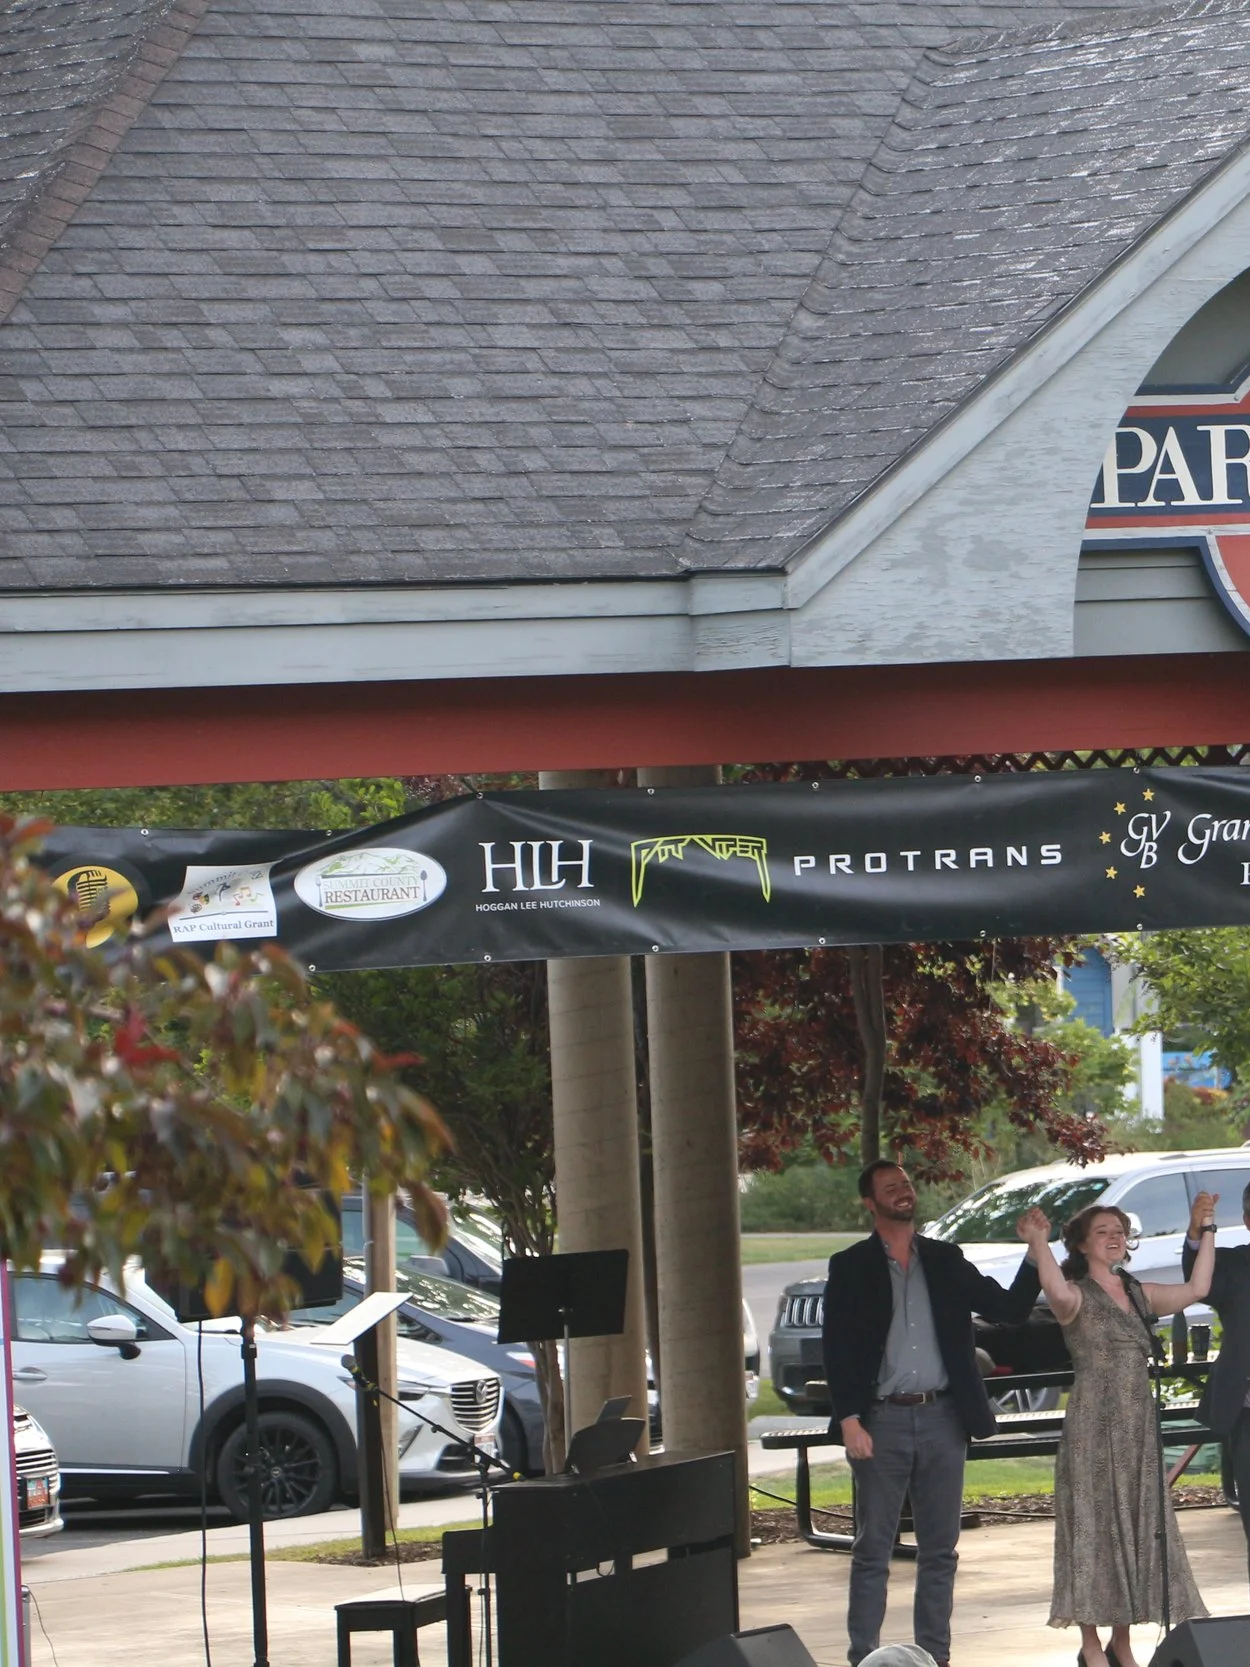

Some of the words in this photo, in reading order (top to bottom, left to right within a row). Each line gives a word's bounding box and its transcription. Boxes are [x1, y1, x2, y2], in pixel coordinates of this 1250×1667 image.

[793, 844, 1063, 876] PROTRANS
[323, 878, 370, 890] SUMMIT
[373, 875, 420, 888] COUNTY
[324, 886, 420, 904] RESTAURANT
[475, 902, 518, 913] HOGGAN
[520, 900, 537, 911] LEE
[540, 898, 601, 910] HUTCHINSON
[173, 924, 197, 934] RAP
[199, 921, 242, 931] Cultural
[244, 919, 275, 929] Grant
